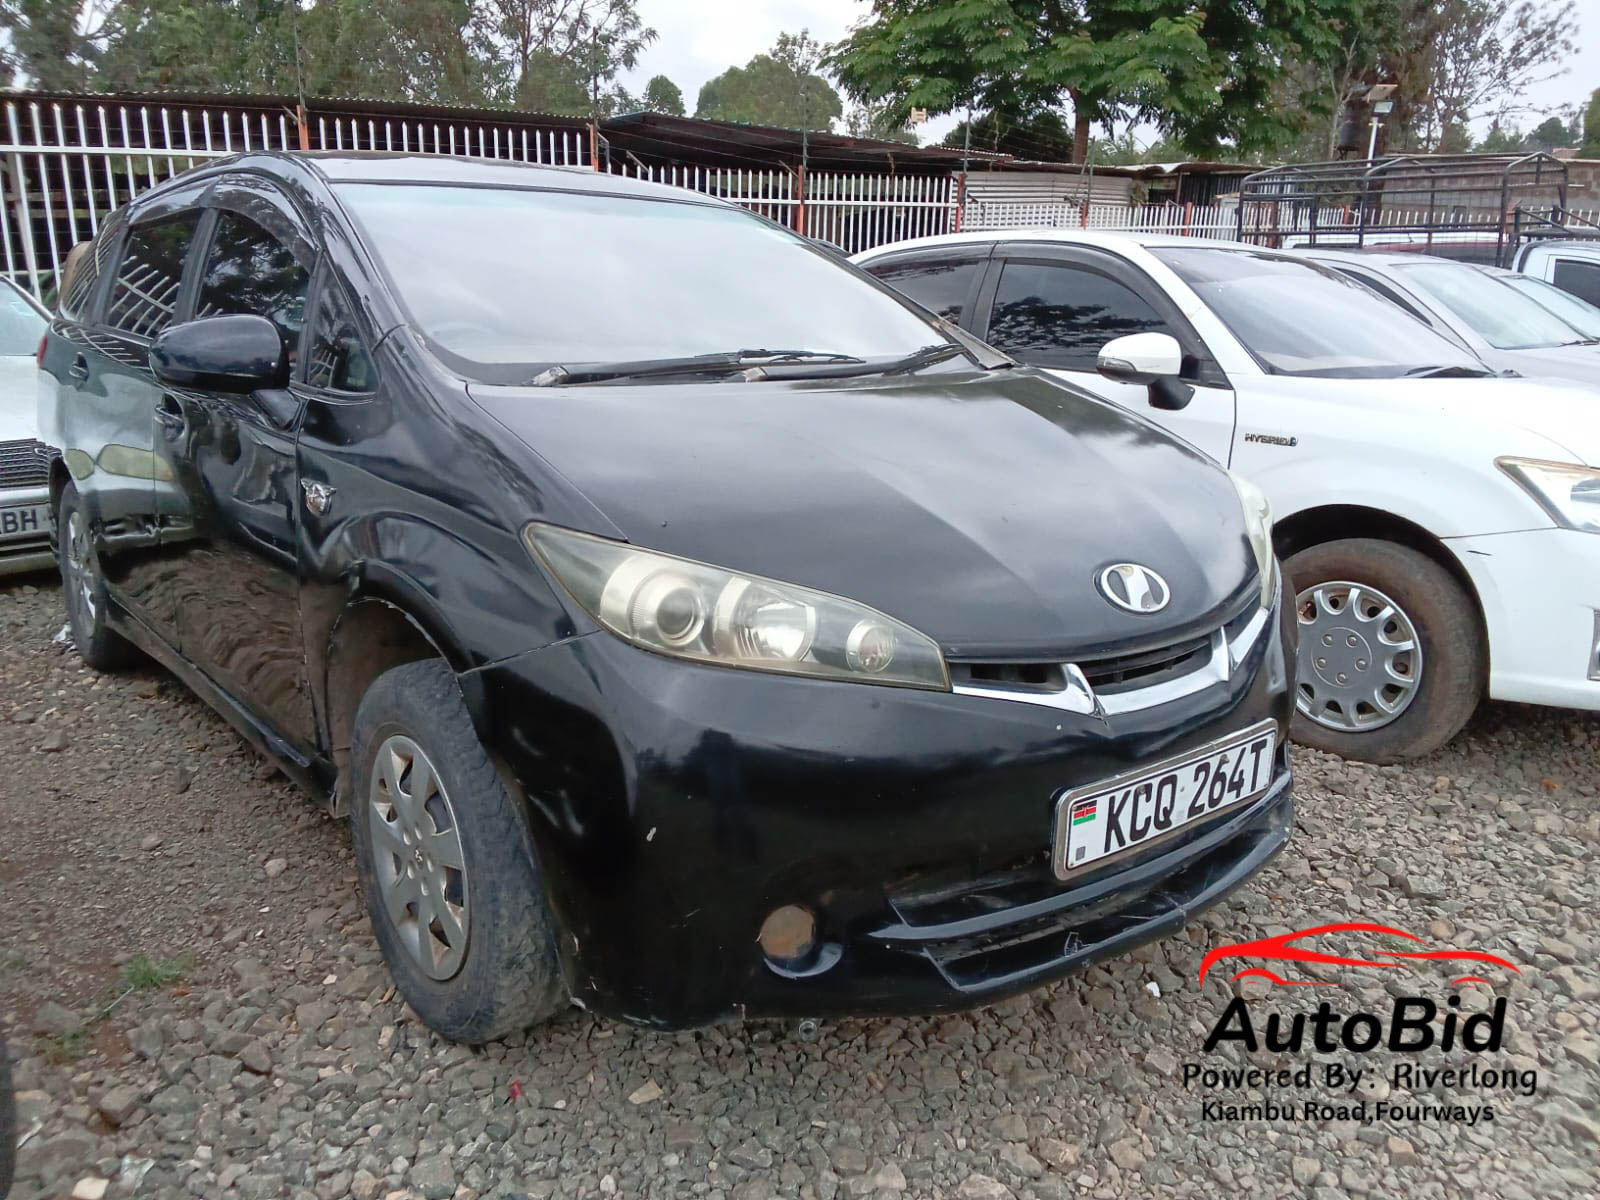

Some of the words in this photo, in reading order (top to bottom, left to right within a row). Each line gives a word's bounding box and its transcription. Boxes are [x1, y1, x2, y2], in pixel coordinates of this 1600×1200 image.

[0, 509, 38, 534] BH
[1104, 774, 1177, 853] KCQ
[1187, 738, 1267, 819] 264T
